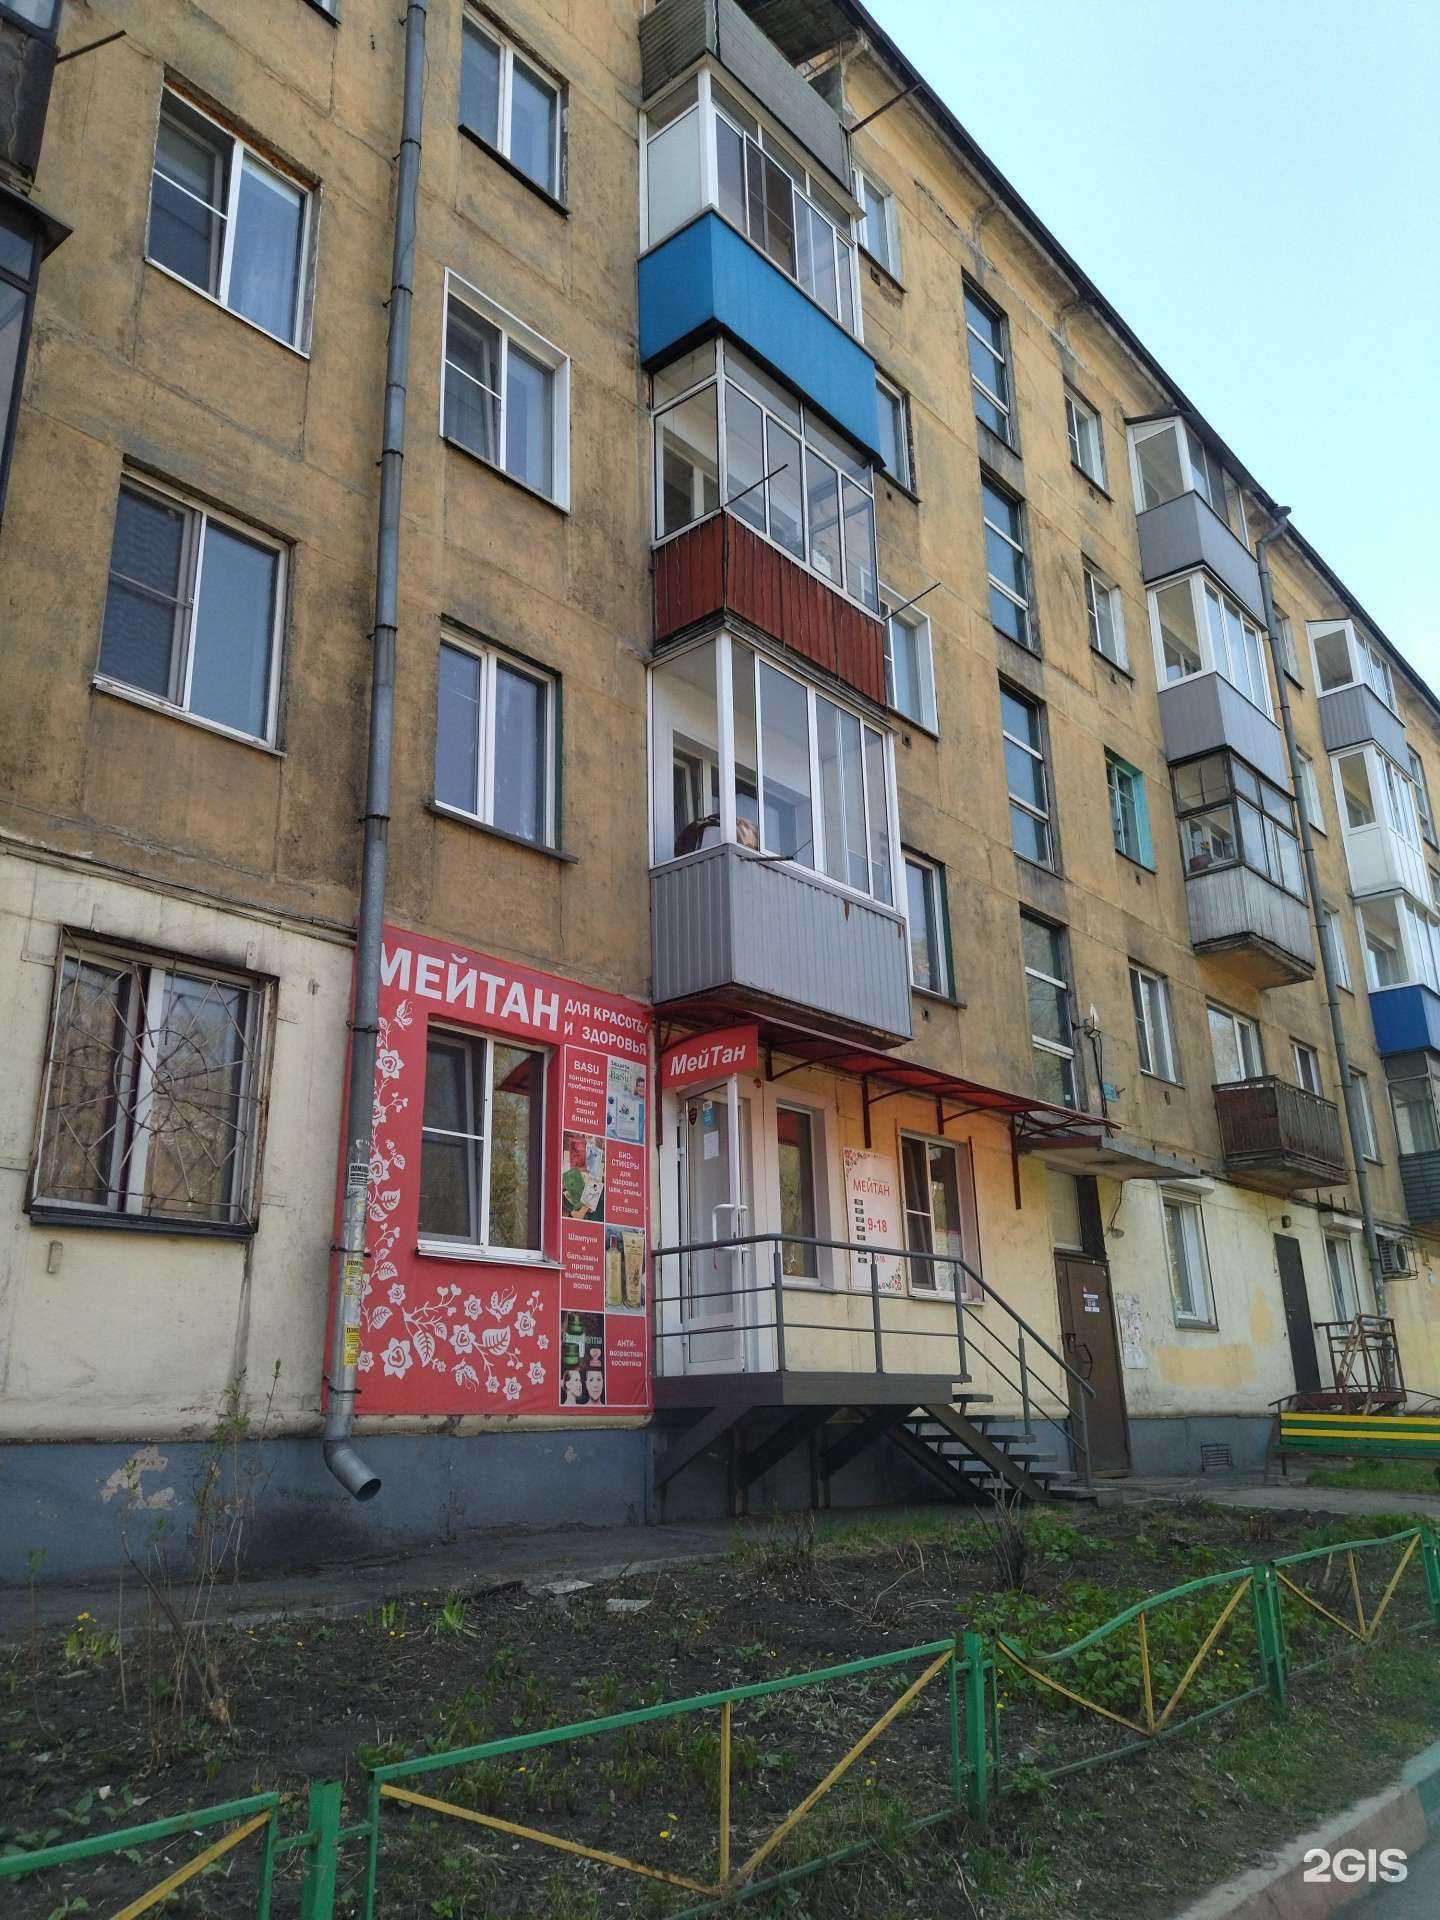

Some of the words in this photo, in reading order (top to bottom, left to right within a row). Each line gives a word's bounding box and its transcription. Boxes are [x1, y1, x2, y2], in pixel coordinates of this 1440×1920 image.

[380, 943, 559, 1032] МЕЙТАН
[564, 999, 590, 1017] ДЛЯ
[593, 1008, 648, 1035] КРАСОТЫ
[564, 1022, 573, 1036] И
[582, 1026, 647, 1056] ЗДОРОВЬЯ
[670, 1045, 746, 1076] МейТан
[574, 1060, 600, 1075] BASU
[574, 1096, 598, 1108] Защити
[576, 1107, 595, 1116] своих
[571, 1114, 599, 1126] близких!
[618, 1151, 633, 1160] БИО-
[611, 1158, 640, 1170] СТИКЕРЫ
[853, 1177, 890, 1198] МЕЙТАН
[611, 1205, 640, 1215] суставов
[867, 1217, 888, 1233] 9-18
[568, 1232, 598, 1244] Шампуни
[566, 1251, 599, 1263] бальзамы
[571, 1263, 594, 1272] против
[573, 1282, 593, 1290] волос
[617, 1339, 637, 1348] АНТИ-
[611, 1360, 642, 1368] косметика
